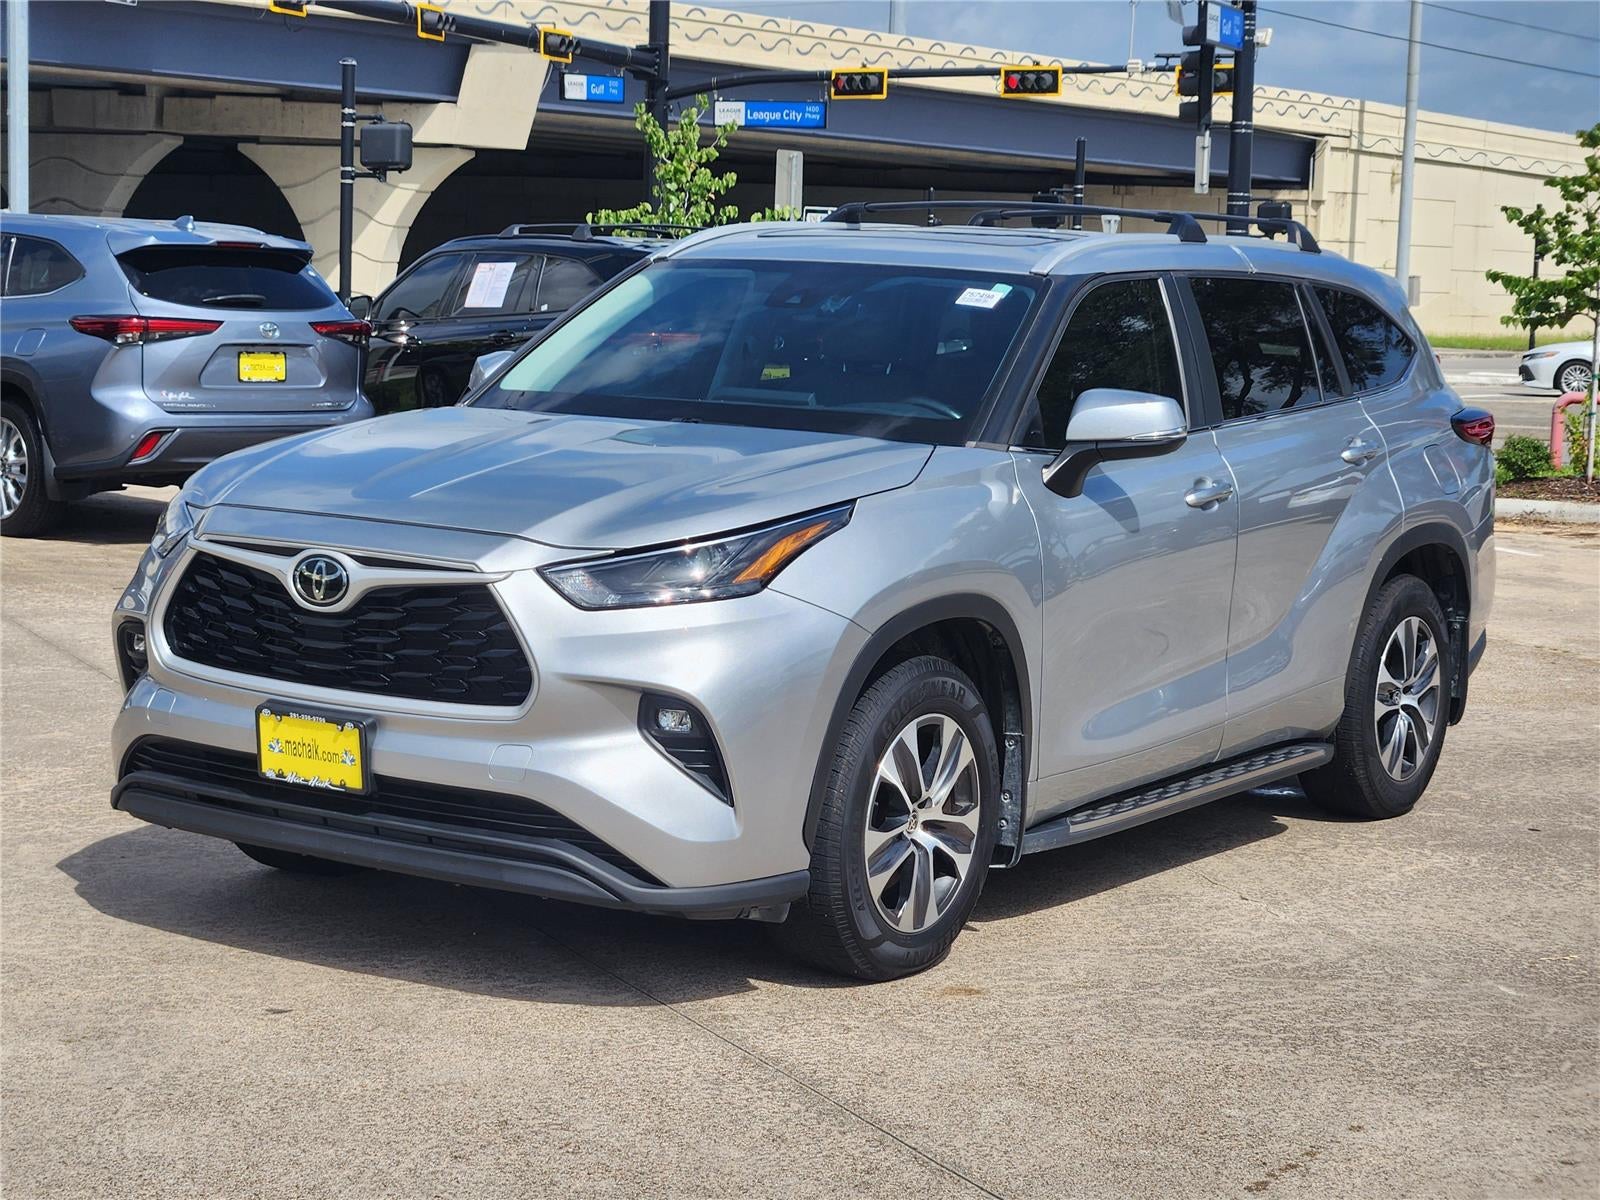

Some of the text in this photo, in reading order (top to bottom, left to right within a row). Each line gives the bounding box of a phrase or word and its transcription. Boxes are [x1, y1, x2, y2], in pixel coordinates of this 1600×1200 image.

[590, 83, 605, 95] Gulf
[747, 109, 782, 122] League
[783, 108, 803, 122] City
[805, 105, 820, 113] 1400
[805, 112, 821, 121] Pkwy
[284, 737, 340, 764] machaik.com
[286, 771, 305, 784] Mac
